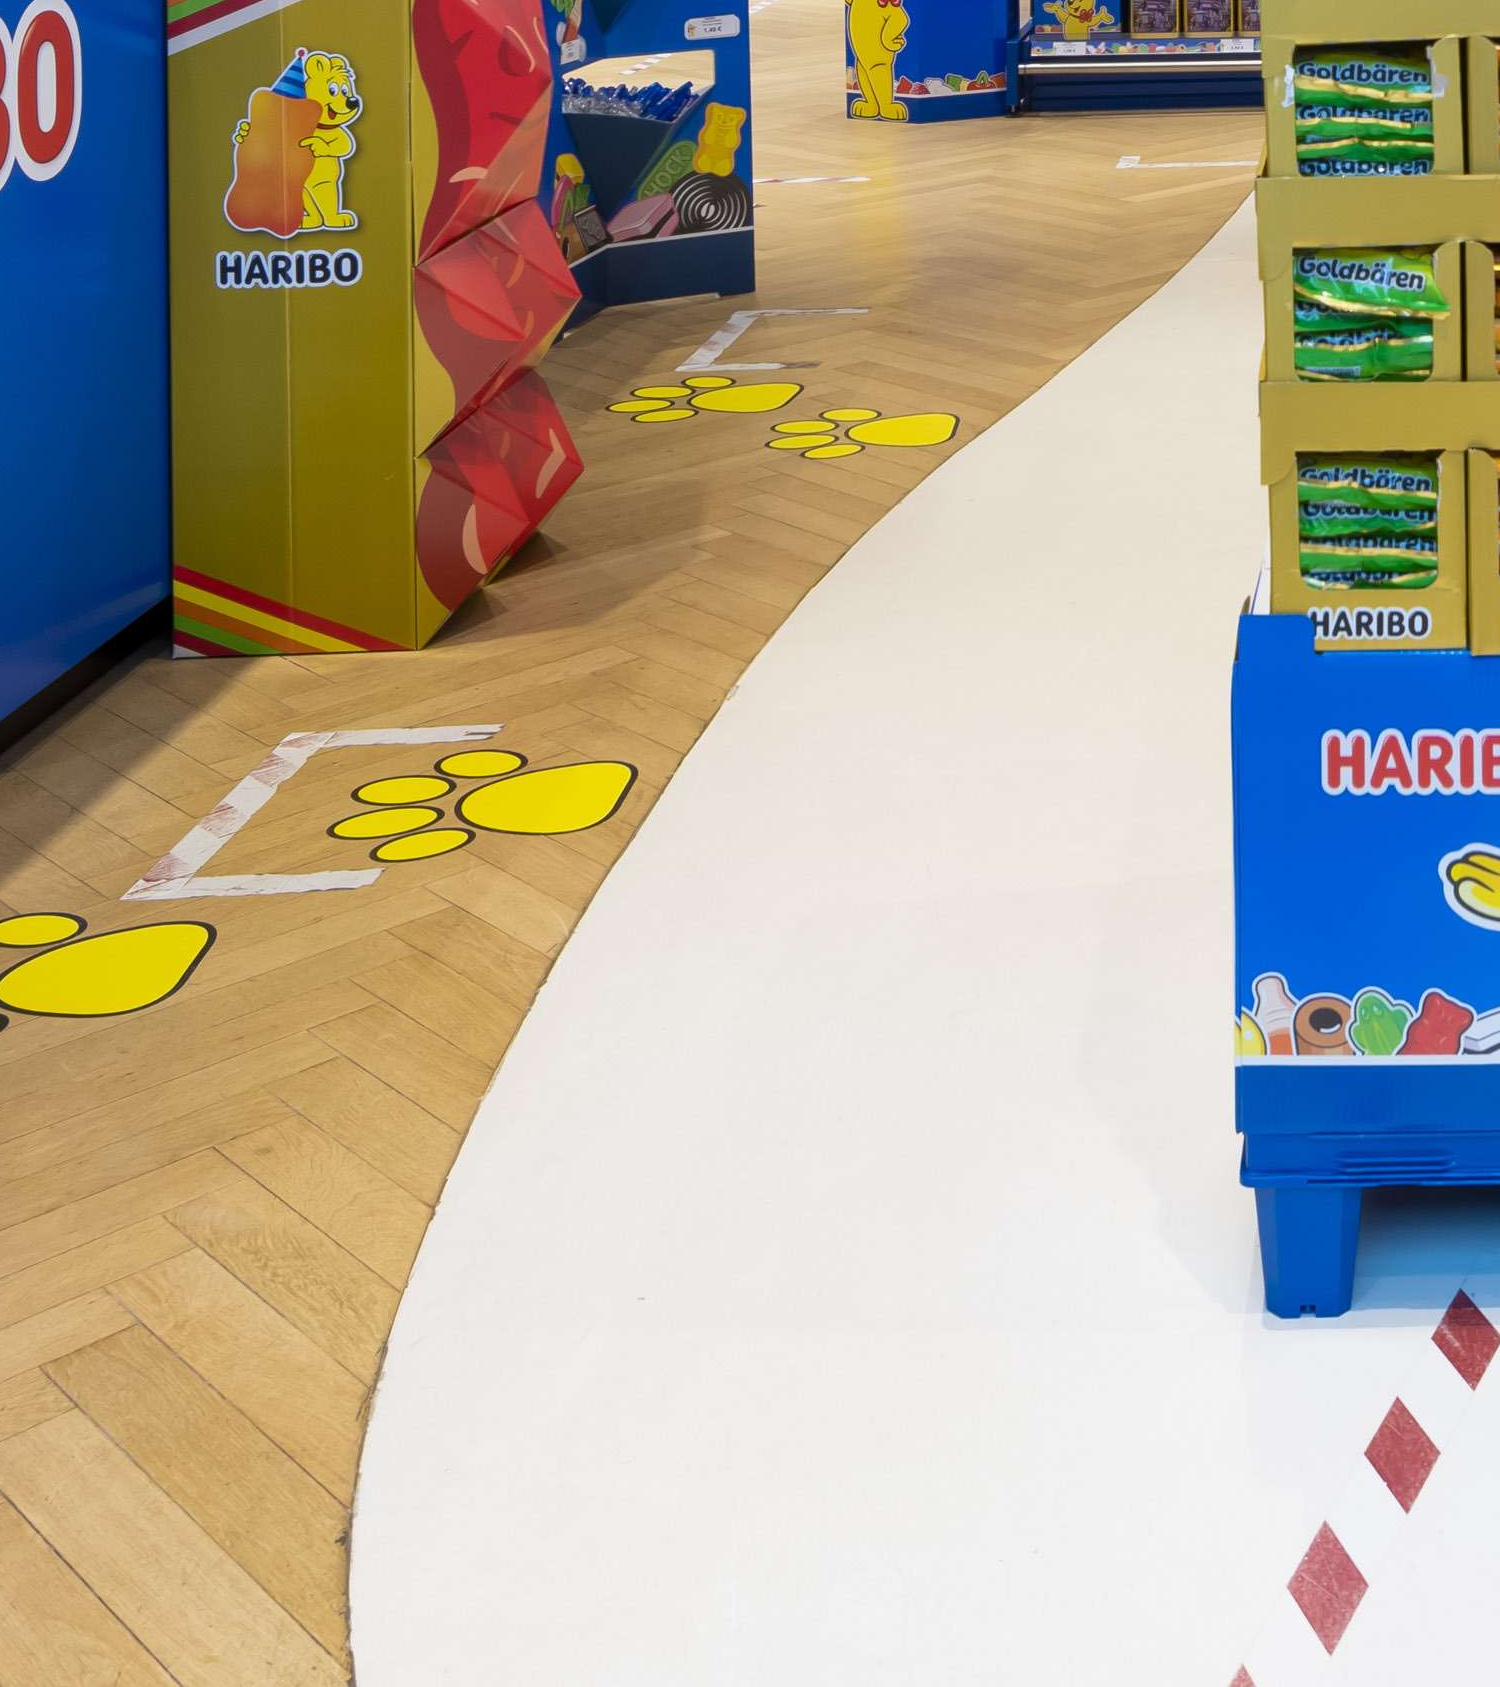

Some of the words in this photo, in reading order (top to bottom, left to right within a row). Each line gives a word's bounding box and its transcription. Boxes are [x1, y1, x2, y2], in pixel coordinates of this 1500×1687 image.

[1298, 63, 1427, 82] Goldbären
[216, 253, 361, 286] HARIBO
[1301, 255, 1424, 292] Goldbären
